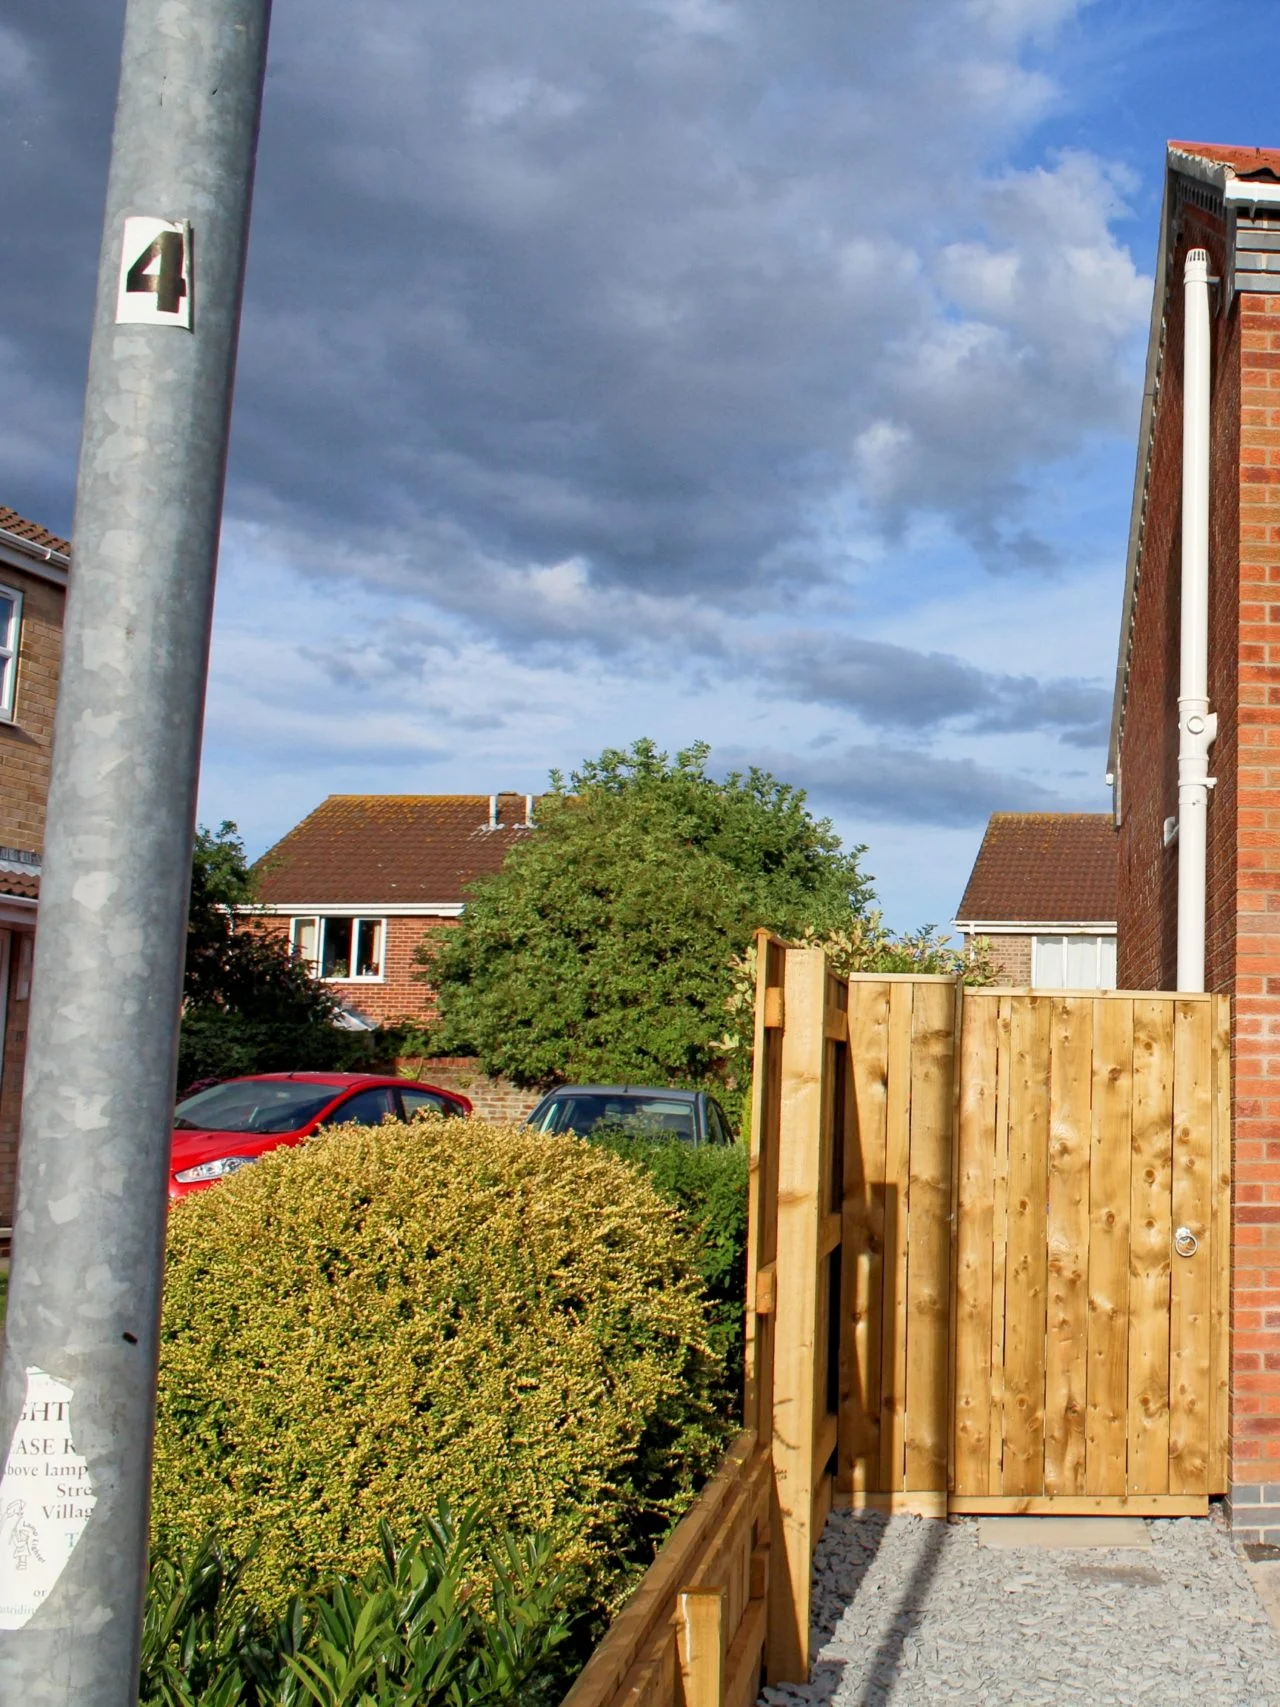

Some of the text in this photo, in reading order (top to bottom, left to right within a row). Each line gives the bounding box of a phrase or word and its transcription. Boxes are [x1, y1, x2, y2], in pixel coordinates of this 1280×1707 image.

[126, 230, 187, 314] 4
[13, 1437, 55, 1456] ASE
[5, 1459, 89, 1480] bove lamp
